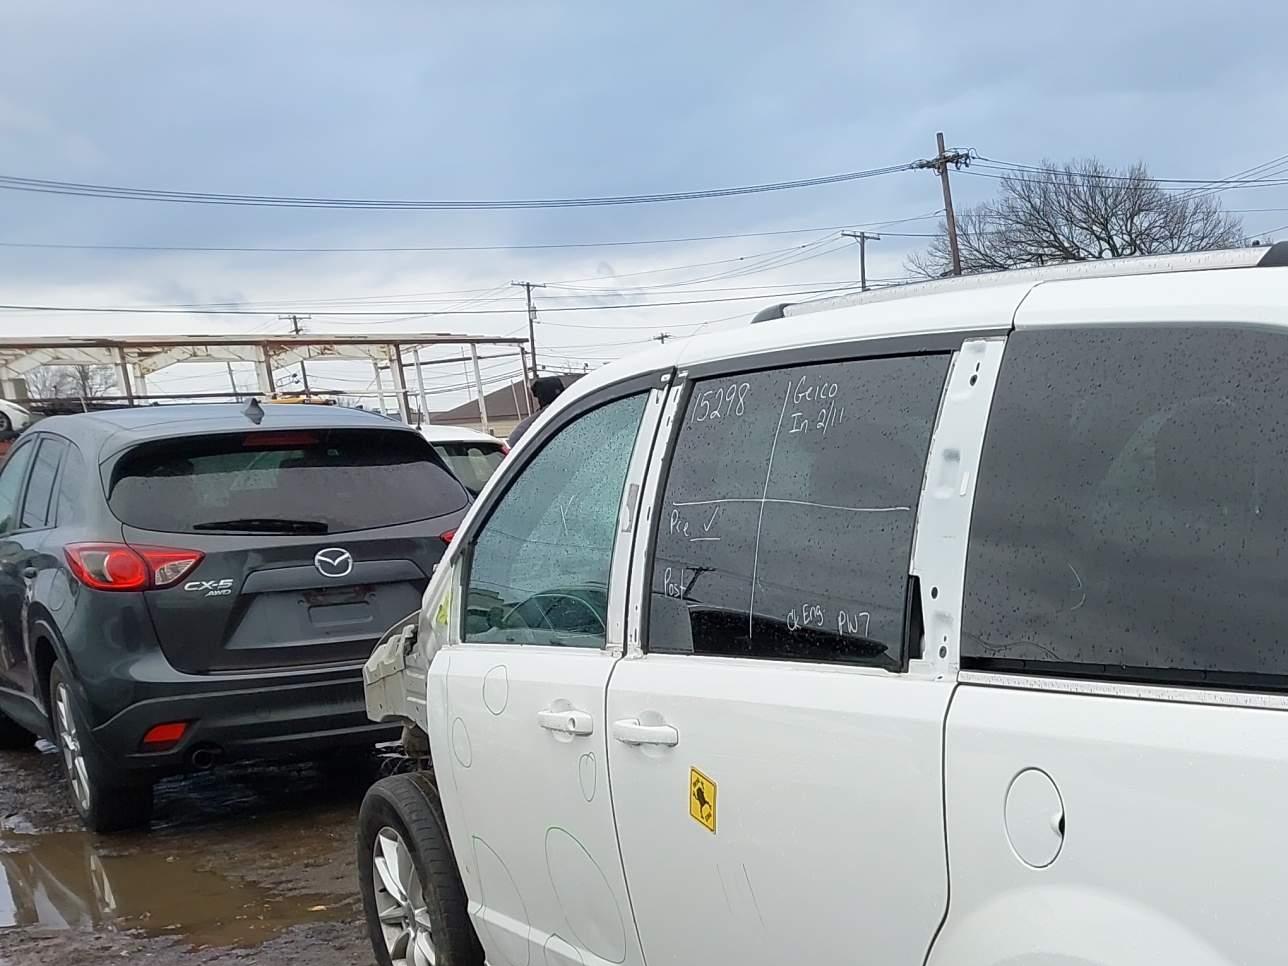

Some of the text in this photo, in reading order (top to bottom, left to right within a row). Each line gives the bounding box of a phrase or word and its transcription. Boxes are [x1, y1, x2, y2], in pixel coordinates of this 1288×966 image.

[691, 383, 750, 424] 15298
[793, 375, 838, 404] Geico
[788, 399, 844, 436] In 2/11
[184, 578, 234, 591] CX-5
[205, 589, 232, 598] AWD
[664, 567, 687, 601] Post
